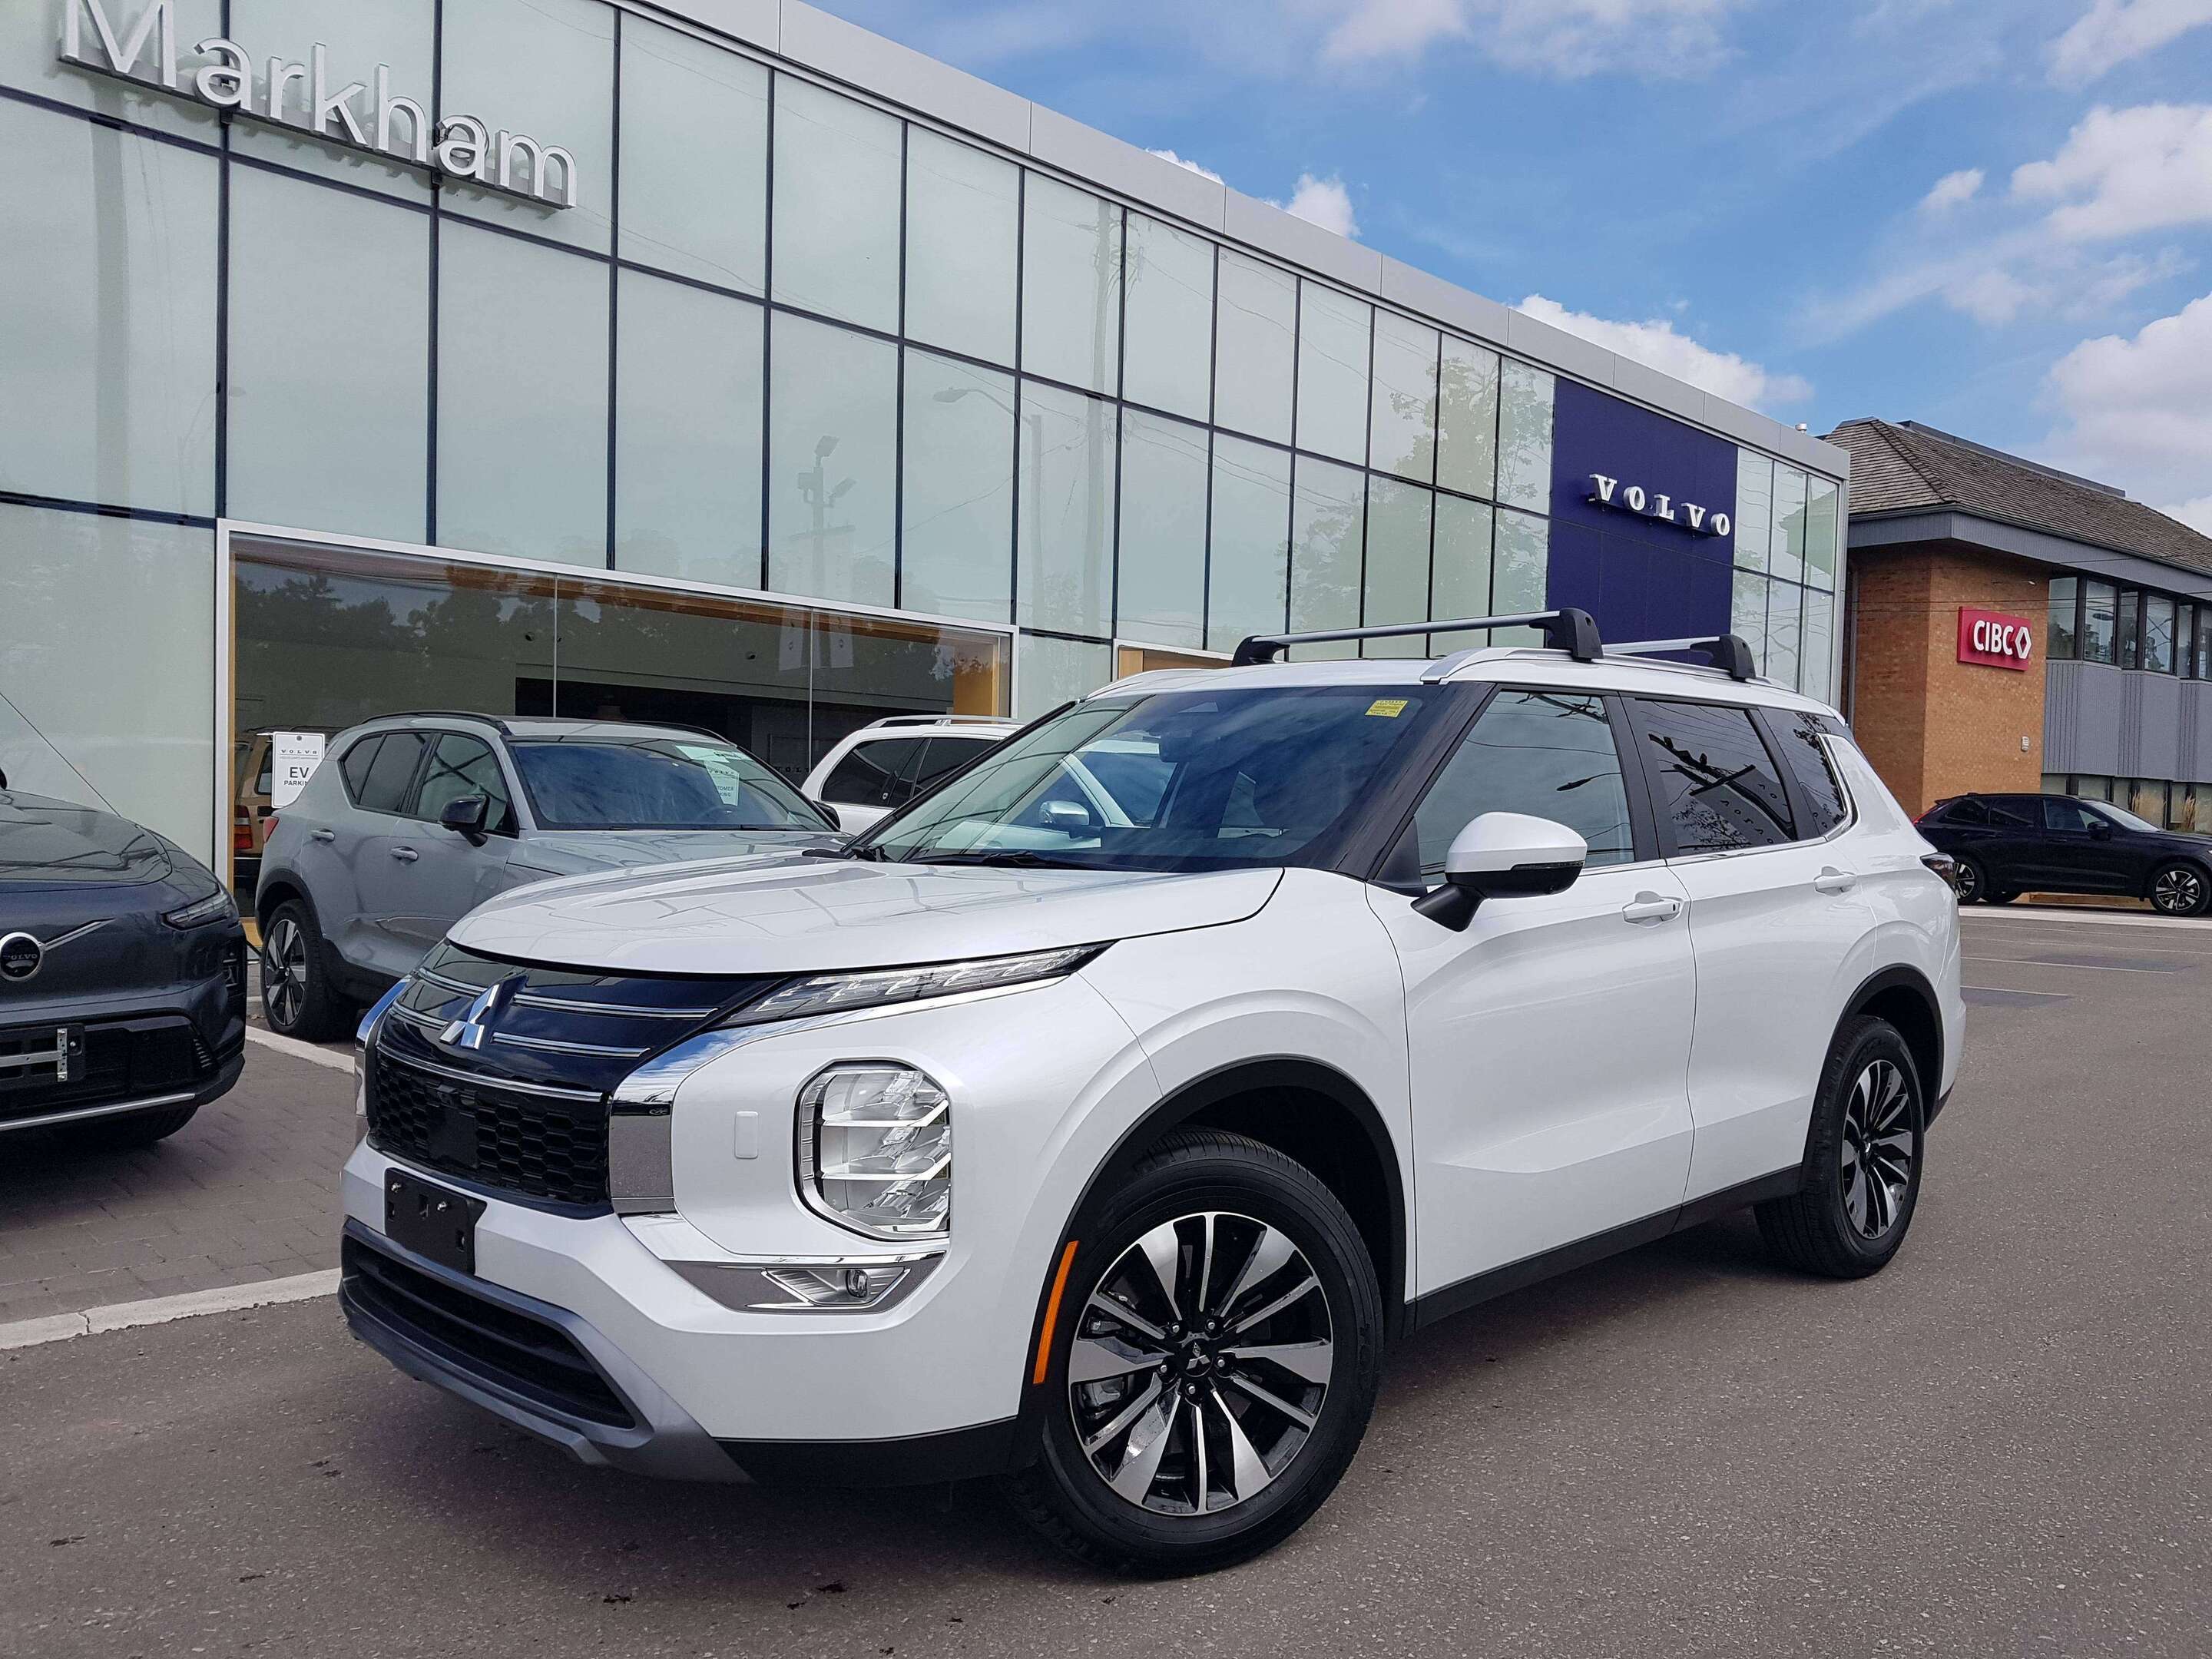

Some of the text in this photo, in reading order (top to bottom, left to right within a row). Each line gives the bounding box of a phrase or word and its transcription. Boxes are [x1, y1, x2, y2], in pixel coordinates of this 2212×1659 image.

[59, 0, 576, 209] Markham
[1588, 473, 1730, 536] VOLVO
[1973, 620, 2014, 655] CIBC
[290, 767, 310, 779] EV
